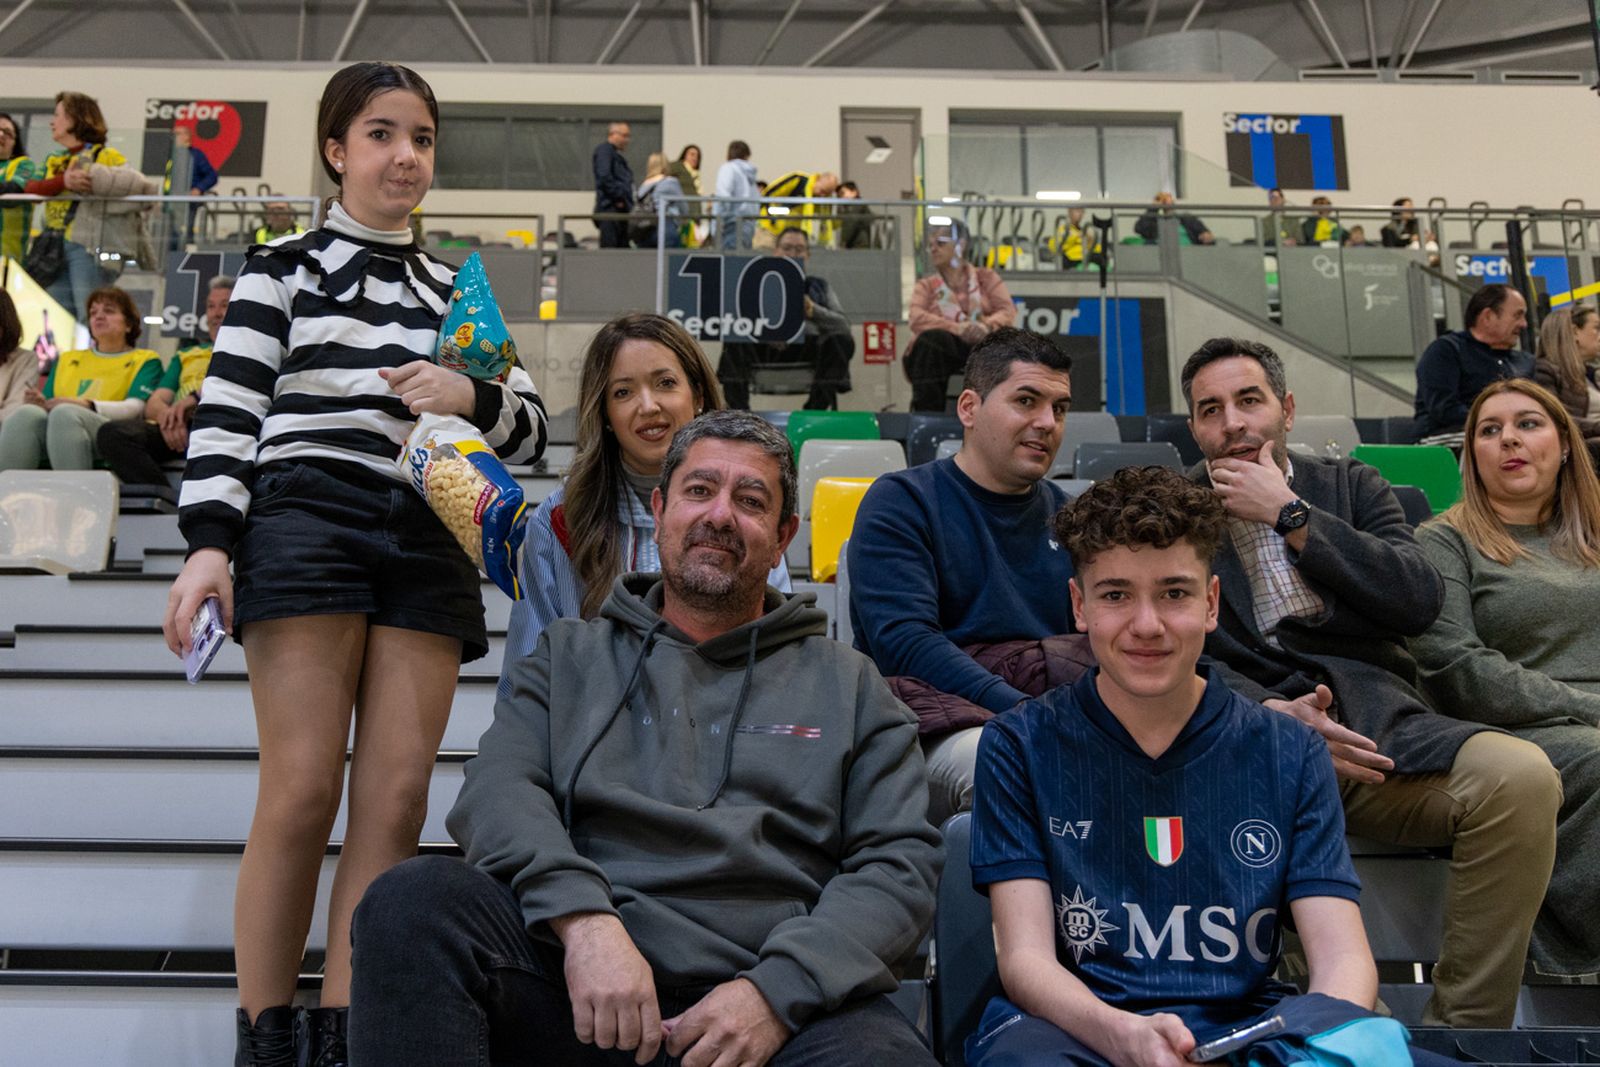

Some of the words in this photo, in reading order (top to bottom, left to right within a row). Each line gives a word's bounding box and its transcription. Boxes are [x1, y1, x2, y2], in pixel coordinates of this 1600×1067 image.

[146, 100, 224, 120] Sector
[1223, 113, 1300, 134] Sector
[1456, 255, 1536, 276] Sectr
[678, 254, 806, 344] 10
[1012, 301, 1081, 335] tor
[1049, 816, 1093, 839] EA7
[1244, 832, 1266, 854] N
[1121, 902, 1283, 963] MSC
